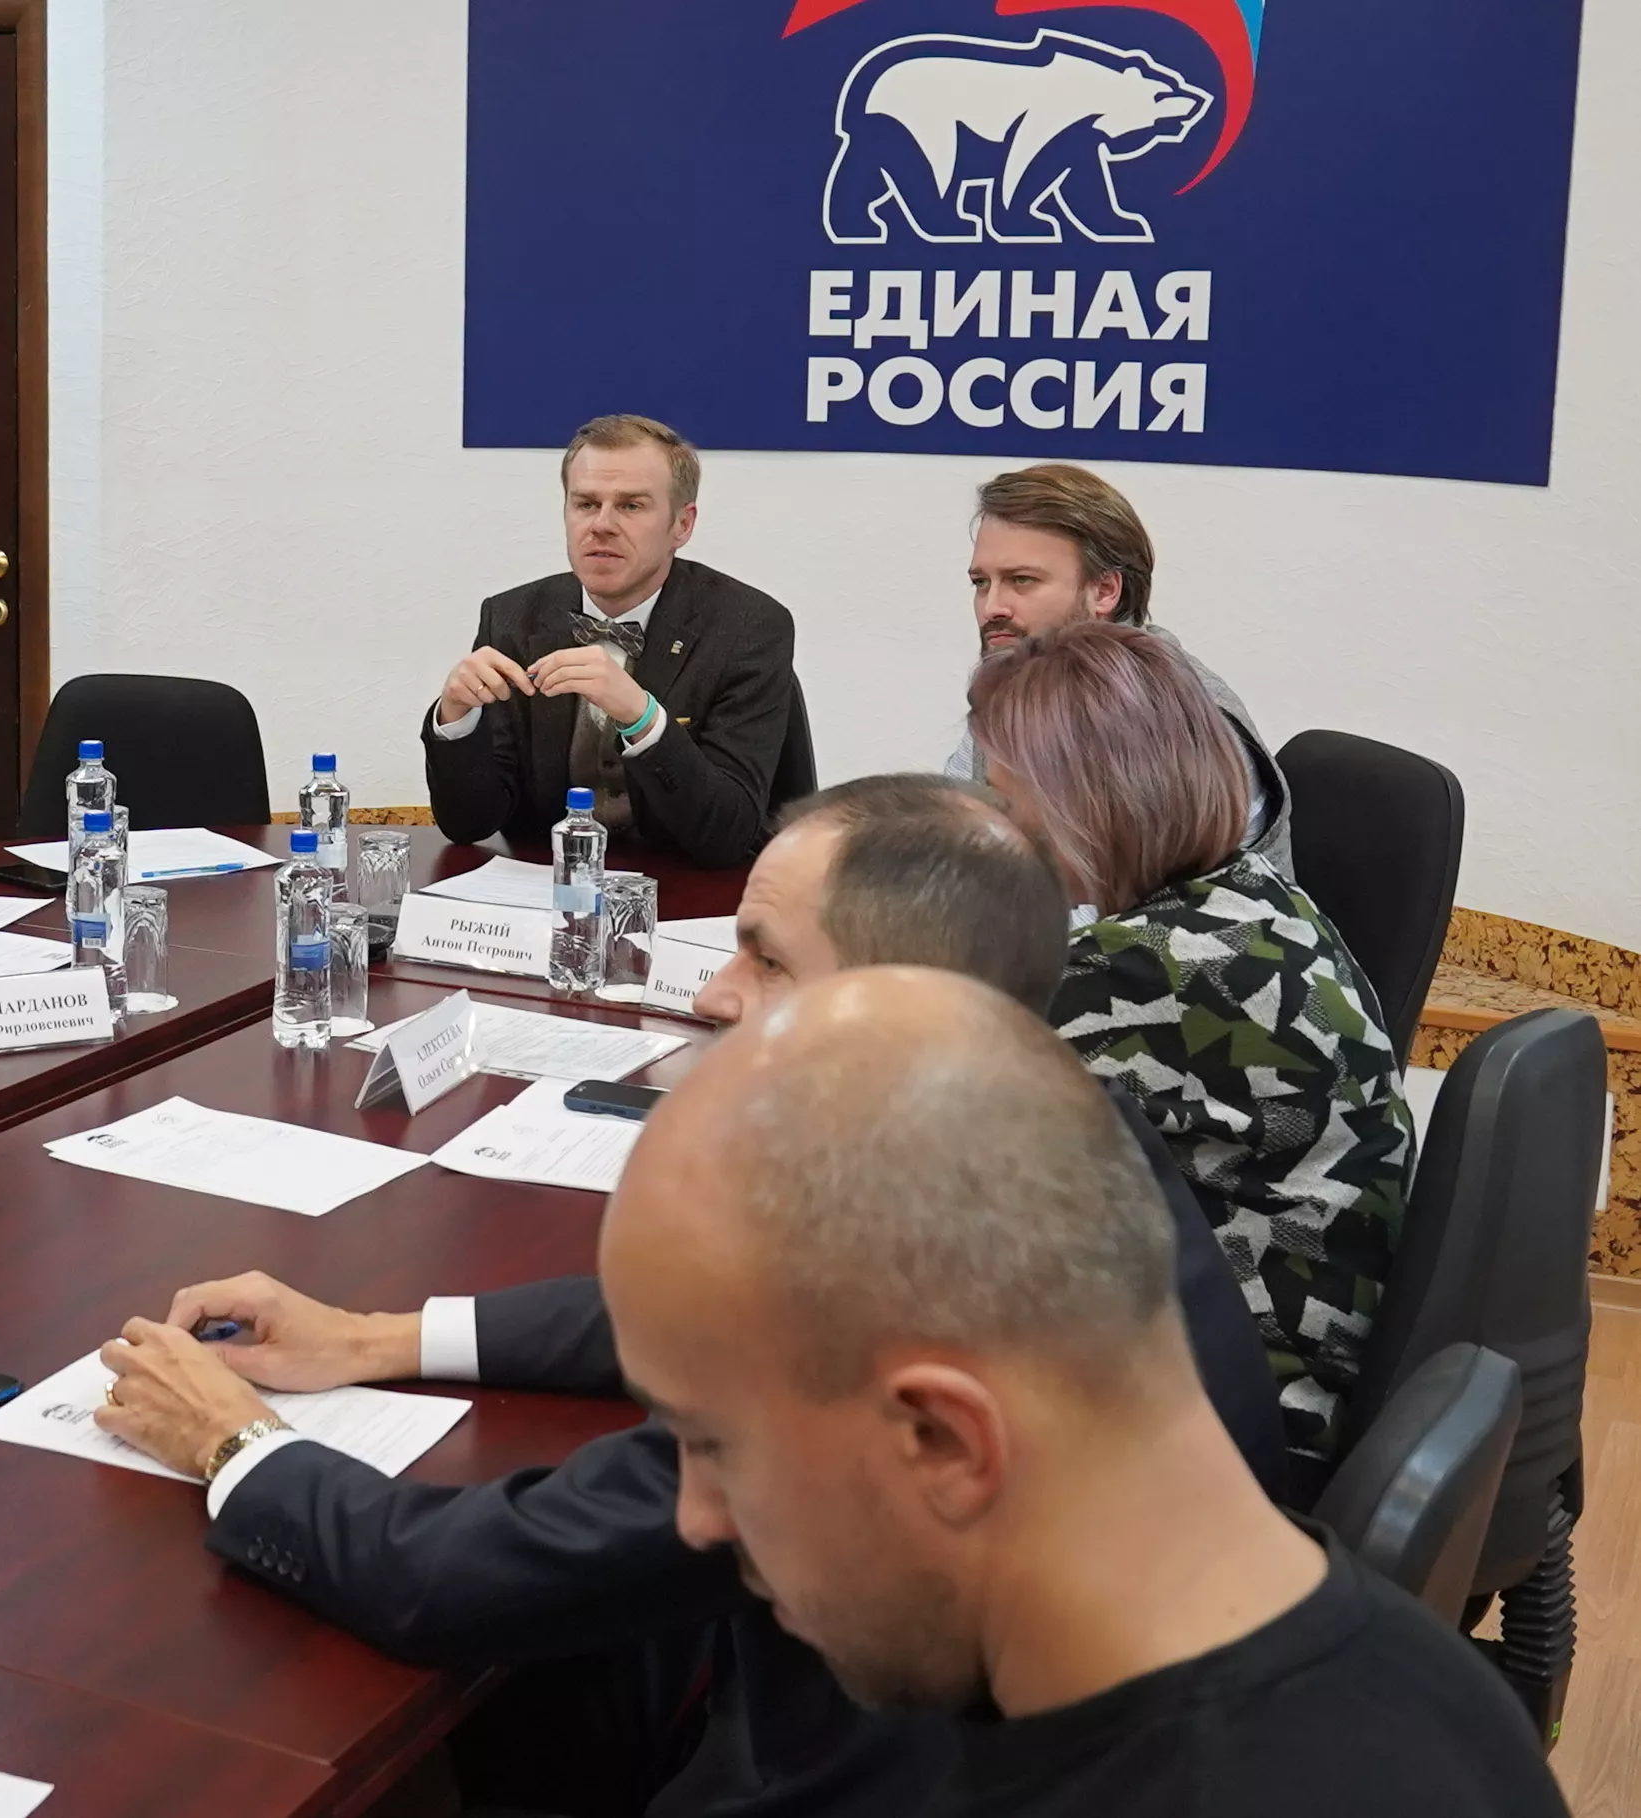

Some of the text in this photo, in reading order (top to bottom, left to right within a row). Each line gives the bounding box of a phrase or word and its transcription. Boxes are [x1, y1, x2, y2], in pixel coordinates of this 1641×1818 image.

[809, 269, 1212, 349] ЕДИНАЯ
[806, 355, 1207, 434] РОССИЯ
[421, 935, 532, 961] Антон Петрович
[450, 918, 511, 938] РЫЖИЙ
[417, 1023, 463, 1063] АЛЕКСЕЕВА
